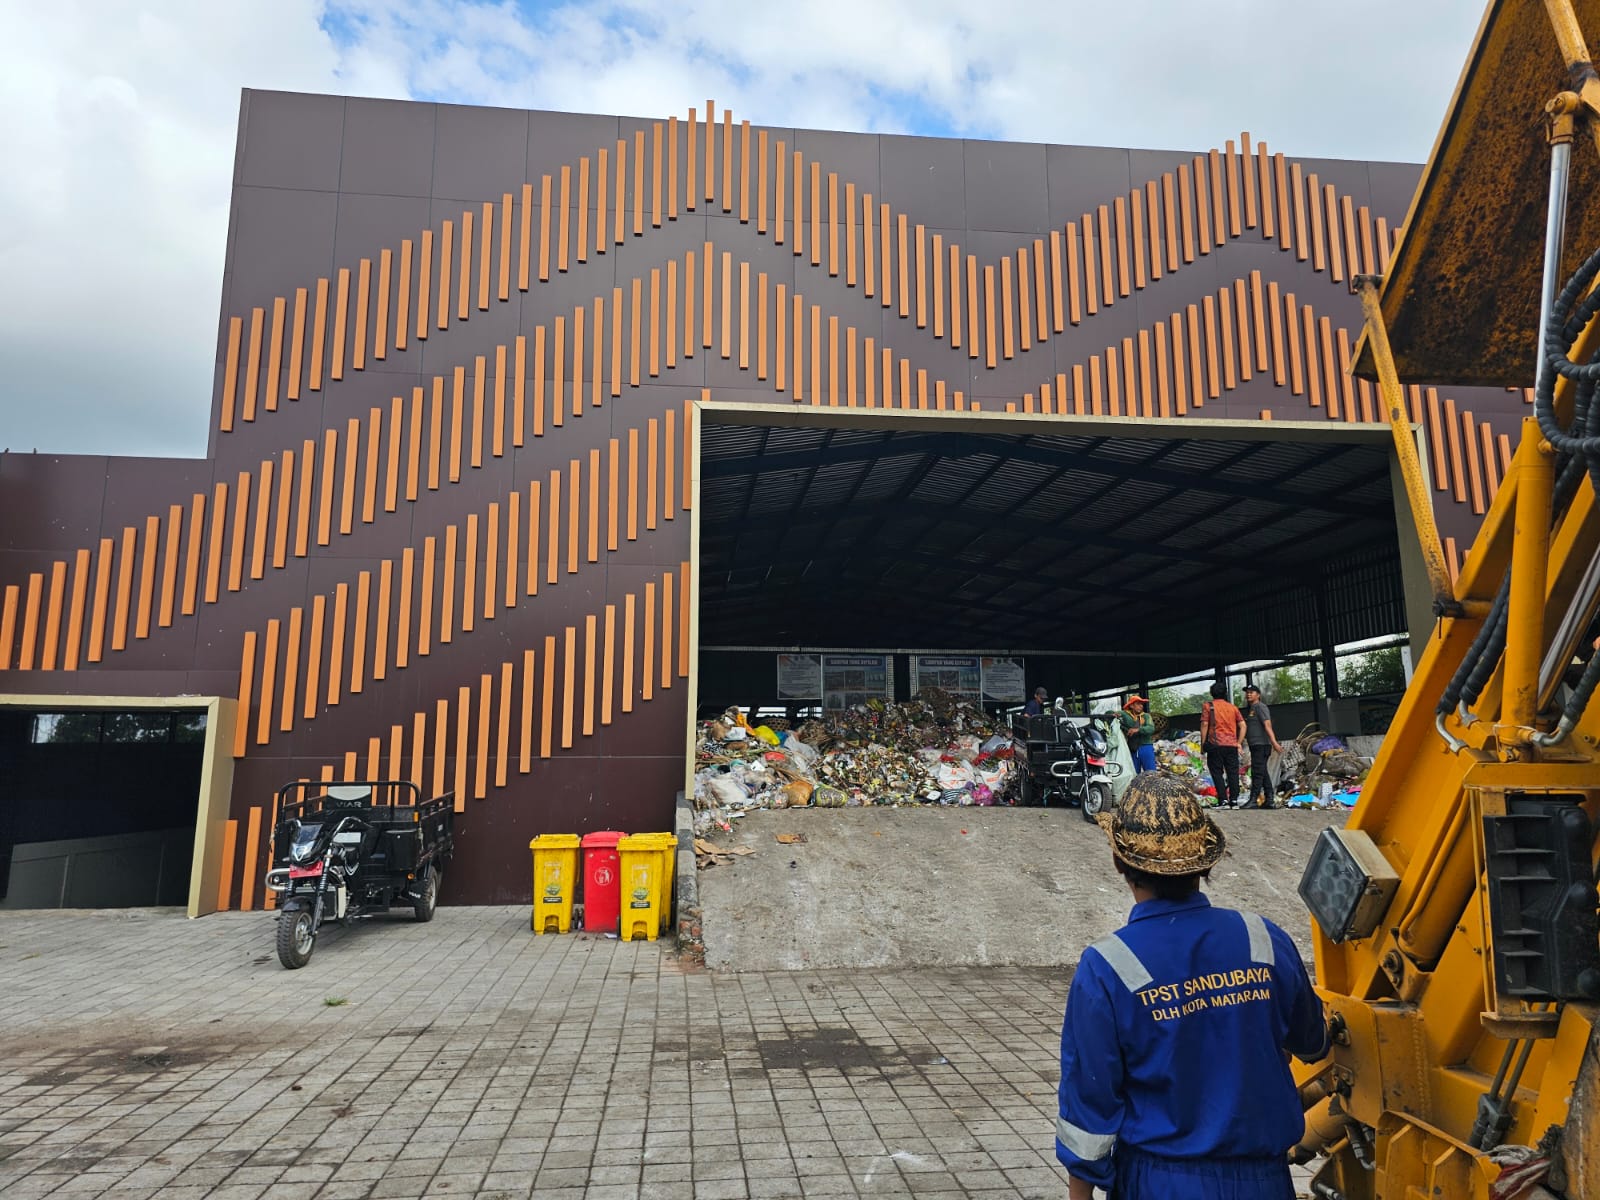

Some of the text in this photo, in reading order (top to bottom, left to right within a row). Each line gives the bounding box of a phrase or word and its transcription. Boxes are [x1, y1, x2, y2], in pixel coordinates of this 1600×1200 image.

[1136, 968, 1272, 1006] TPST SANDUBAYA
[1152, 989, 1270, 1021] DLH KOTA MATARAM
